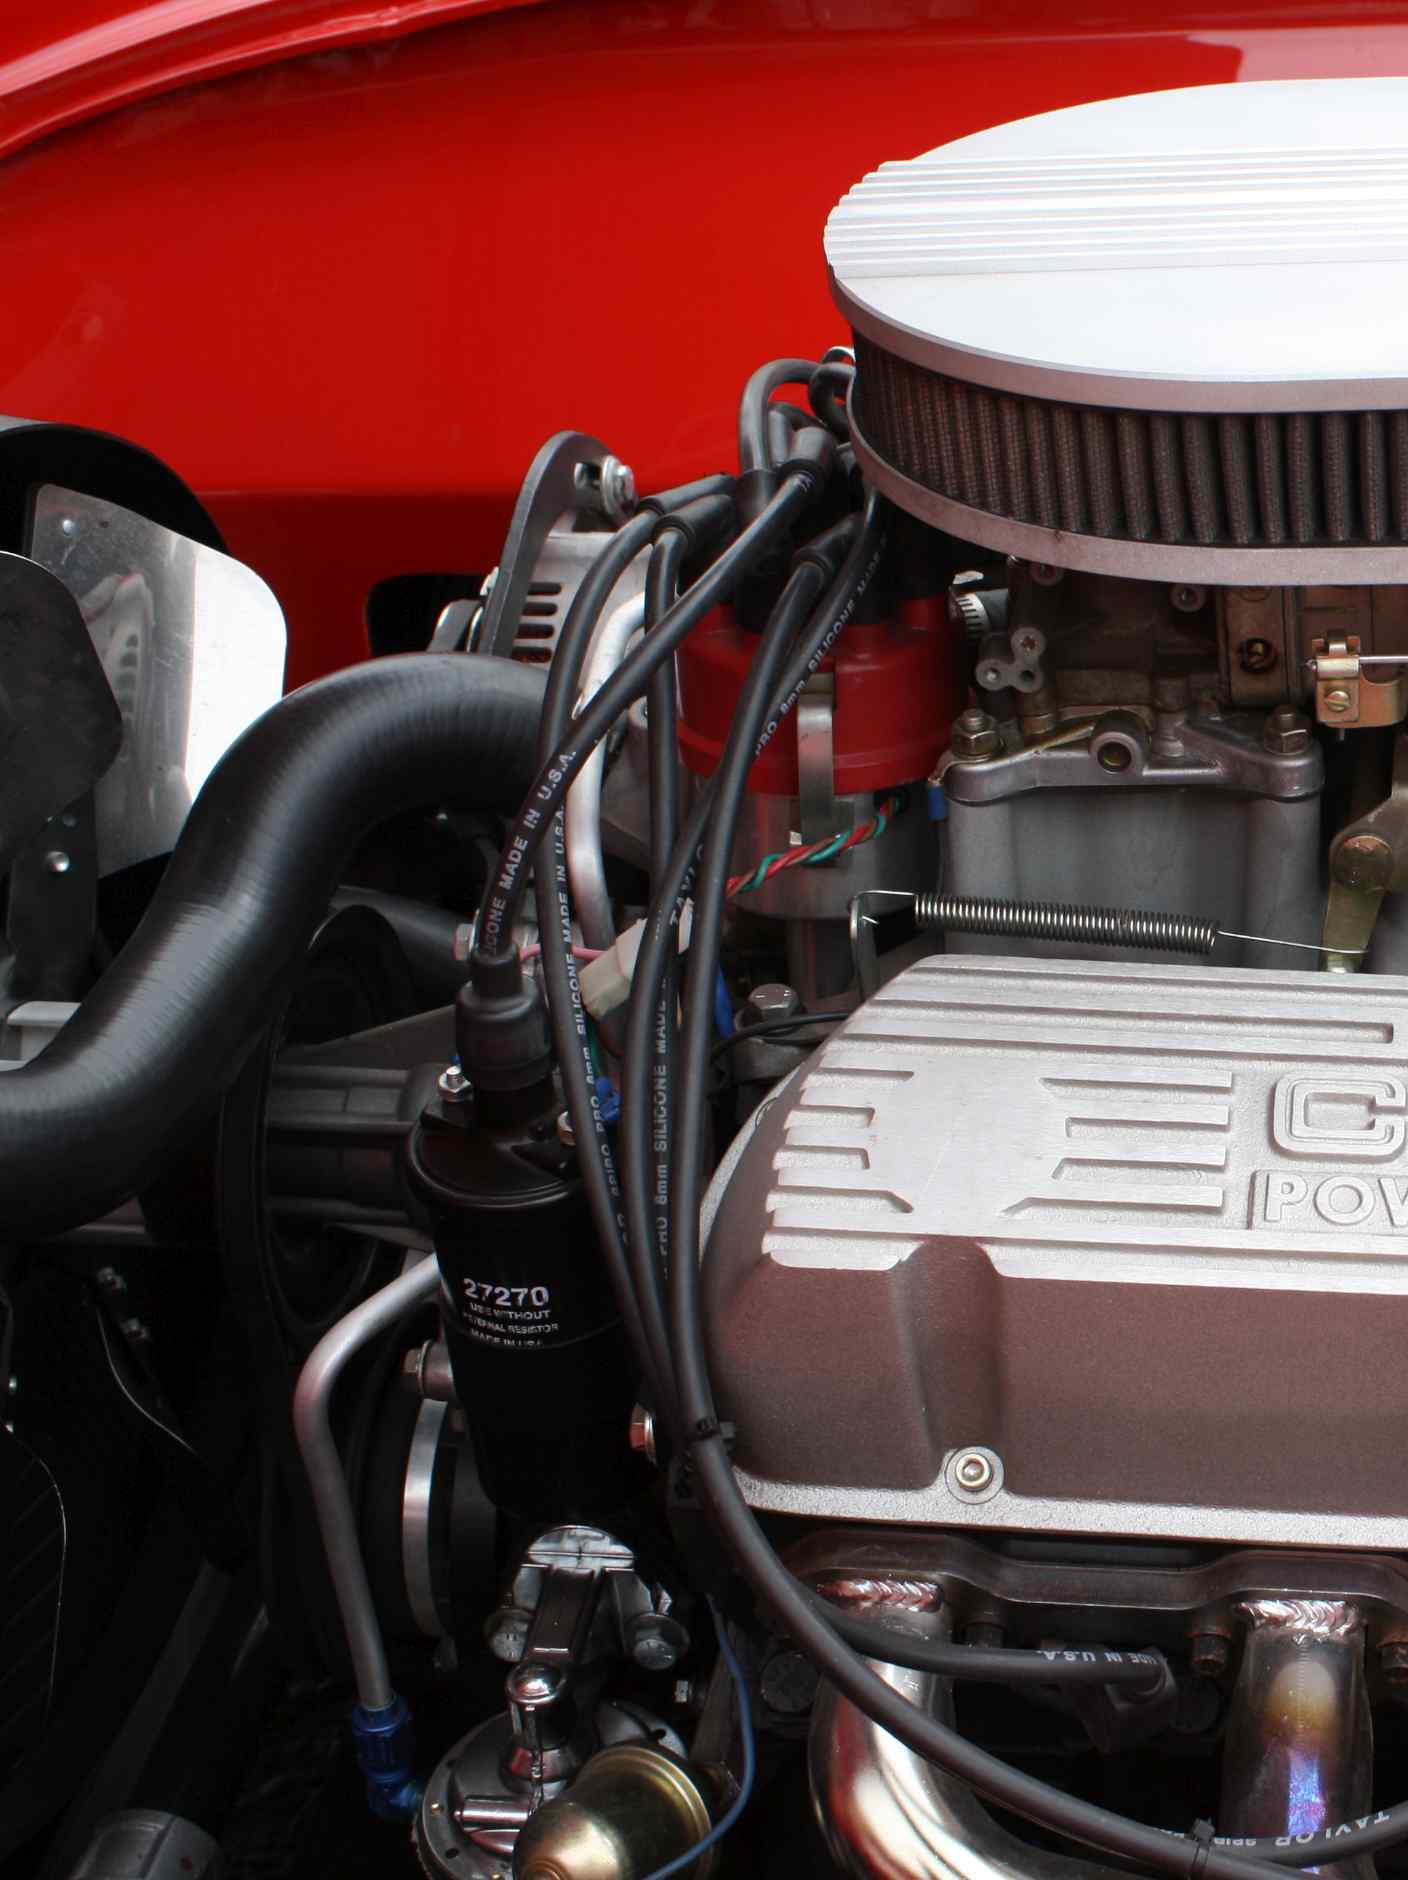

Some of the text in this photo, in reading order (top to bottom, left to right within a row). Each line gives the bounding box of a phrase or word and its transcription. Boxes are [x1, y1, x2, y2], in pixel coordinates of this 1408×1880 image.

[499, 834, 528, 890] MADE
[523, 808, 542, 830] IN
[537, 751, 577, 801] U.S.A.
[556, 865, 568, 882] IN
[558, 892, 574, 944] MADE
[565, 953, 587, 1036] SILICONE
[653, 1065, 668, 1153] SILICONE
[463, 1278, 550, 1306] 27270
[492, 1308, 551, 1321] WITHOUT
[507, 1322, 560, 1335] RESISTOR
